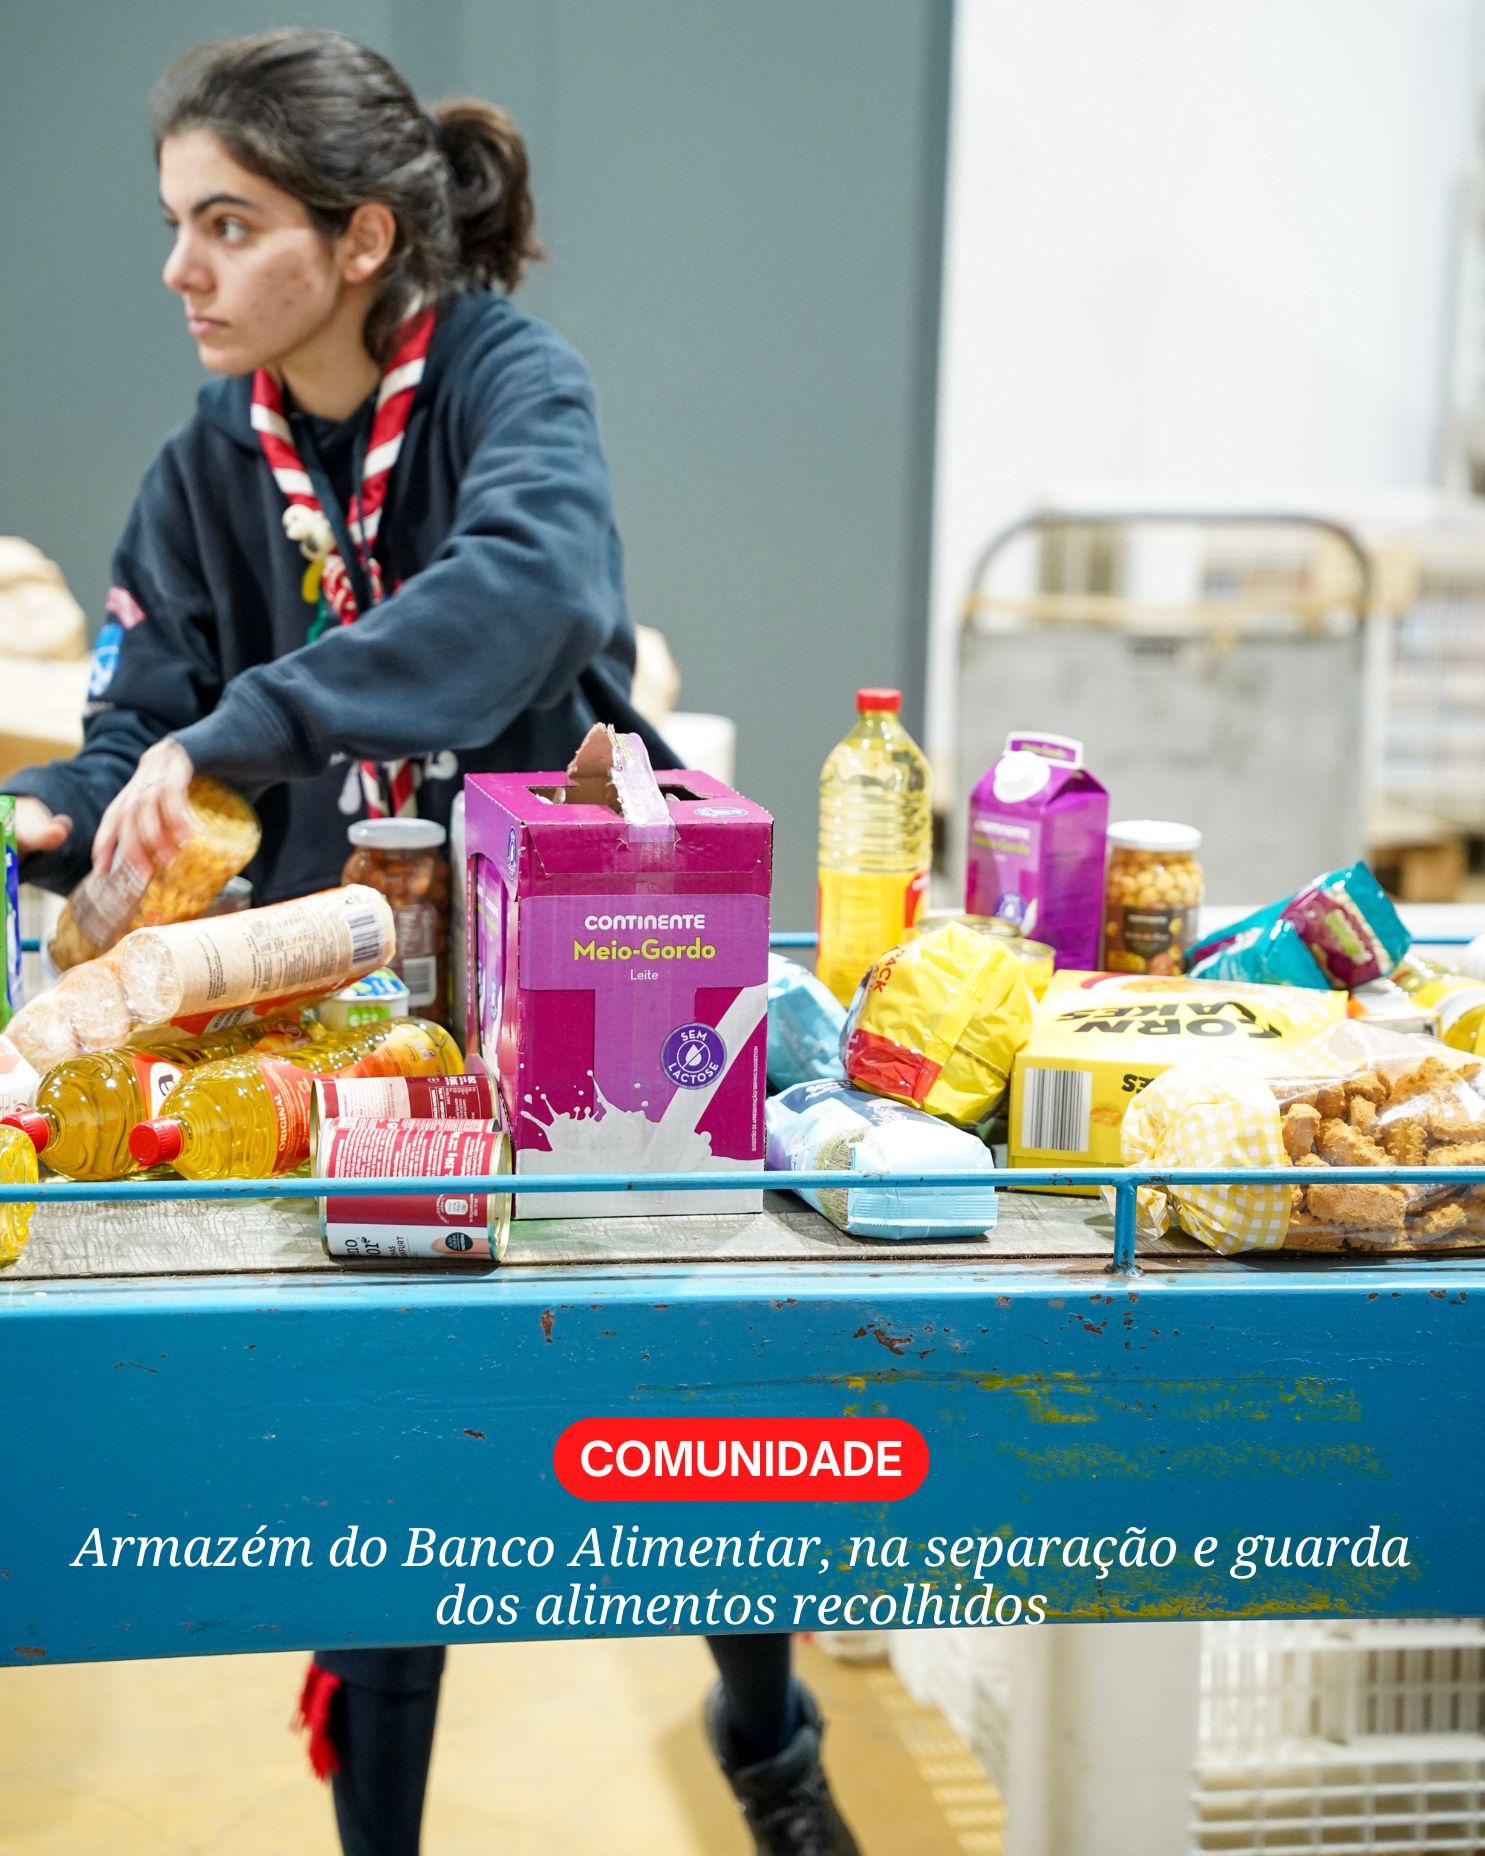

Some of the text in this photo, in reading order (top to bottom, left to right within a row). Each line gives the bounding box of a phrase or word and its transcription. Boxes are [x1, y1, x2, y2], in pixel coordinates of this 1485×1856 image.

[573, 936, 717, 961] Meio-Gordo
[629, 969, 659, 981] Leite
[680, 1029, 708, 1042] SEM
[667, 1061, 720, 1084] LACTOSE
[274, 1094, 288, 1152] ORIGINAL
